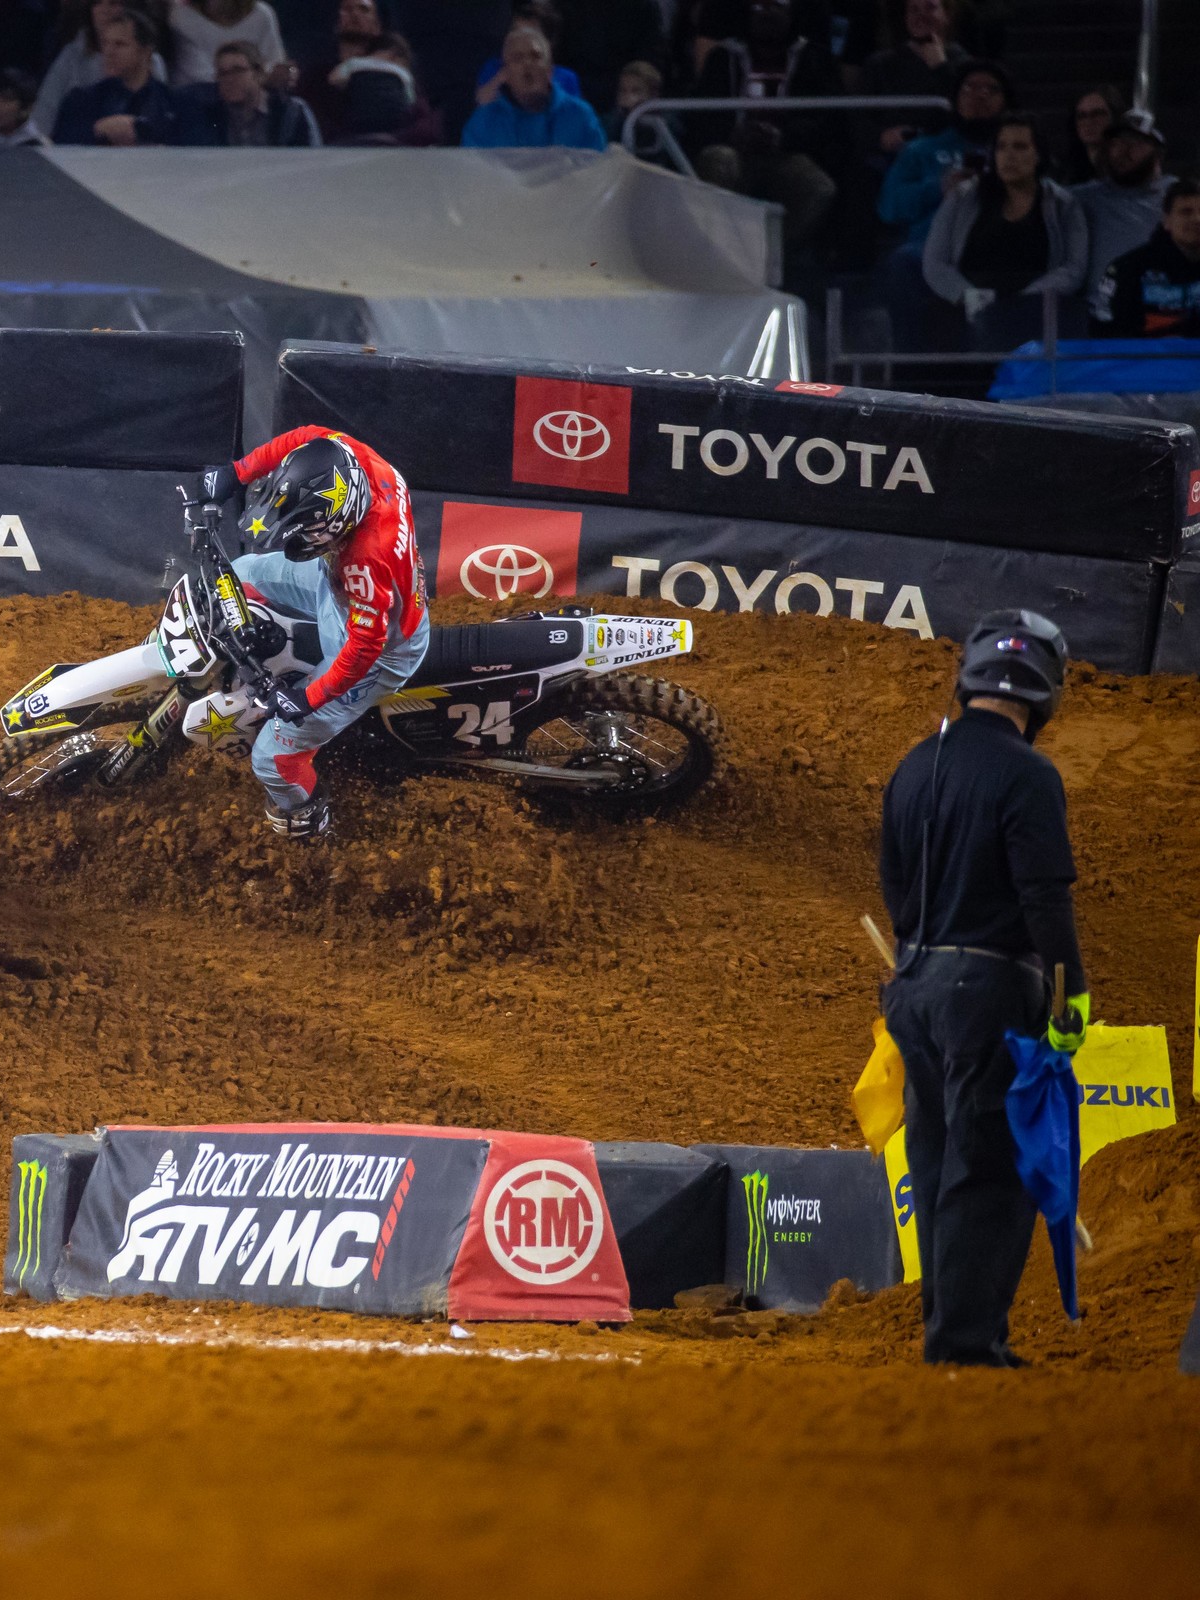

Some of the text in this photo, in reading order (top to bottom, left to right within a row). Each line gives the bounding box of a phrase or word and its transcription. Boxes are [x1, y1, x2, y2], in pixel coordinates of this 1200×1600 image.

[626, 366, 764, 387] TOYOTA
[659, 424, 934, 493] TOYOTA
[282, 523, 303, 540] Airoh
[612, 556, 934, 640] TOYOTA
[612, 617, 677, 627] DUNLOP
[160, 602, 202, 674] 24
[613, 644, 676, 665] DUNLOP
[448, 701, 514, 745] 24
[275, 734, 294, 747] FLY
[1078, 1085, 1170, 1108] ZUKI
[176, 1143, 406, 1201] ROCKY MOUNTAIN
[508, 1197, 581, 1248] RM
[766, 1194, 822, 1226] MONSTER
[773, 1231, 812, 1243] ENERGY
